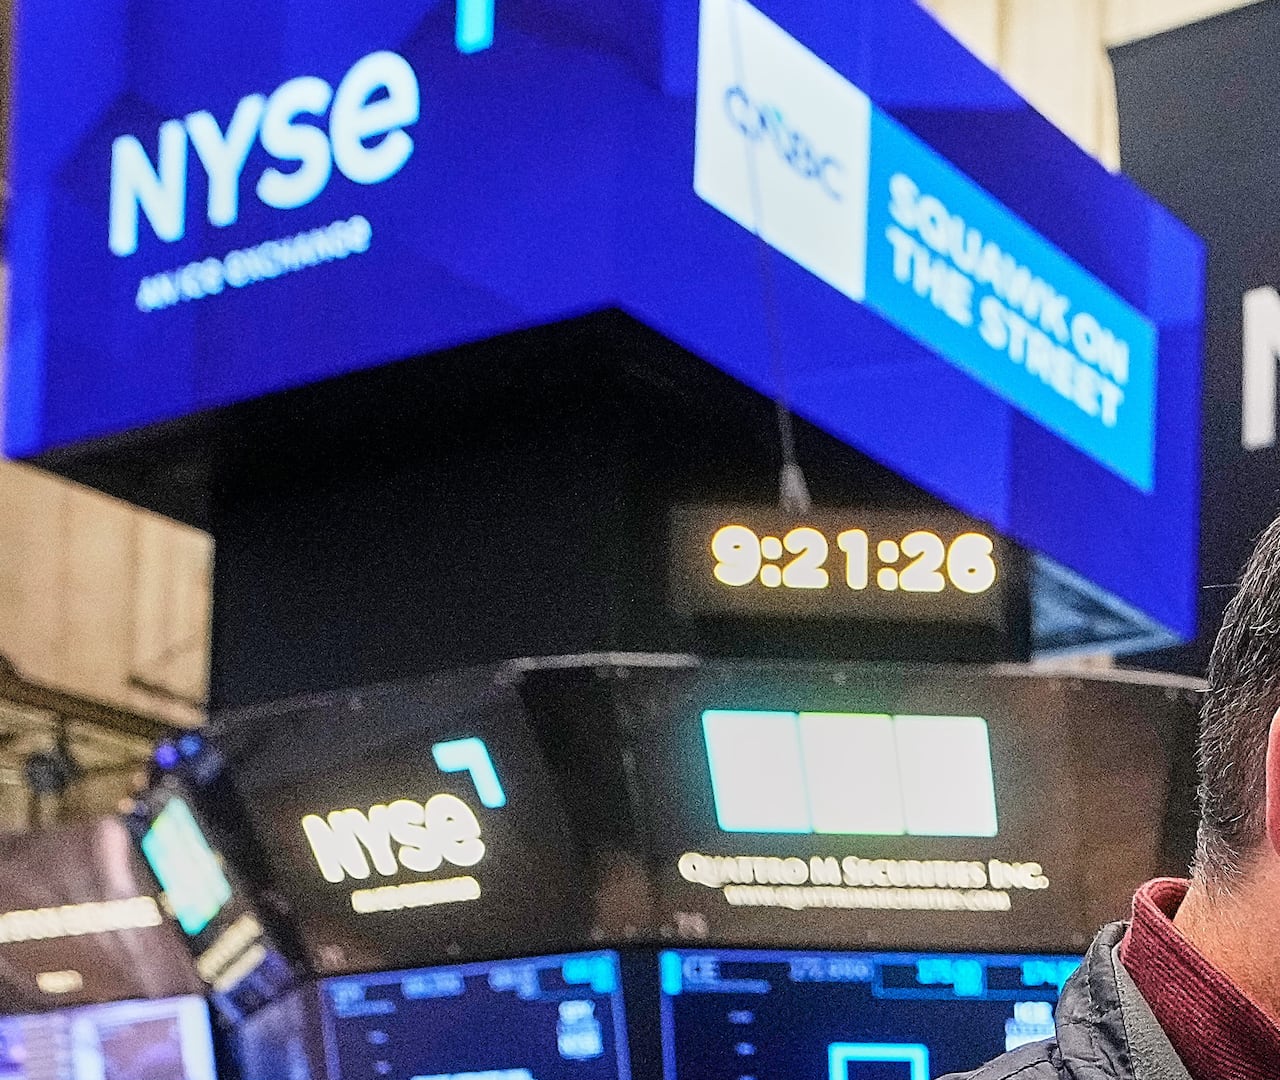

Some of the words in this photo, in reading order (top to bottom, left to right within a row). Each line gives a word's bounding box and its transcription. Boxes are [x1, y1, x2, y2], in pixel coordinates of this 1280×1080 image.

[886, 225, 975, 327] THE
[978, 297, 1125, 428] STREET
[888, 173, 1072, 343] SQUAWK
[1070, 306, 1129, 384] ON
[712, 525, 996, 593] 9:21:26
